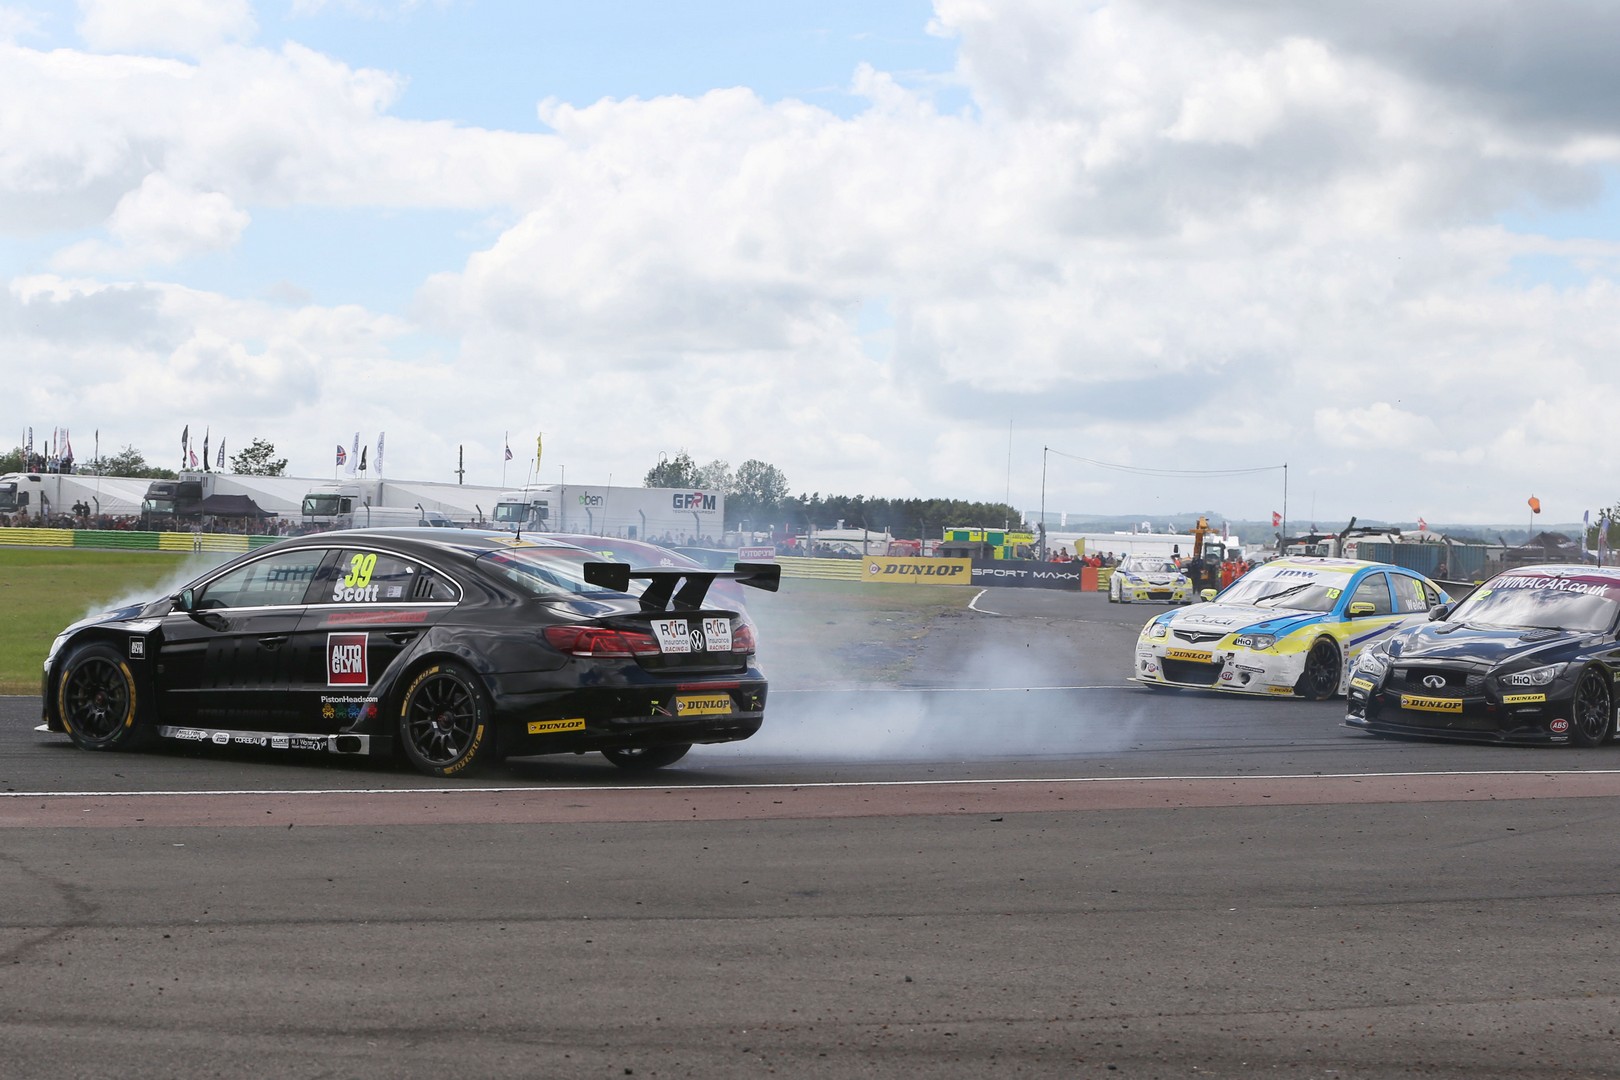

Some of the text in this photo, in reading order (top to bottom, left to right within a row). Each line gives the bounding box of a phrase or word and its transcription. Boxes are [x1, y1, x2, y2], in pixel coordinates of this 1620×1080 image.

[672, 492, 716, 510] GPRM
[344, 553, 377, 588] 39
[883, 564, 963, 576] DUNLOP
[972, 568, 1080, 580] SPORT MAXX
[1273, 568, 1319, 579] jmw
[332, 578, 379, 602] Scott
[1325, 588, 1340, 600] 13
[1412, 579, 1426, 601] 13
[1405, 599, 1427, 611] Welch
[1236, 638, 1252, 646] HiQ
[331, 644, 362, 660] AUTO
[1173, 650, 1213, 661] DUNLOP
[331, 658, 363, 674] GLYM
[1512, 675, 1531, 686] HiQ
[687, 700, 730, 710] DUNLOP
[1411, 699, 1462, 710] DUNLOP
[539, 721, 583, 731] DUNLOP
[1552, 721, 1567, 729] ABS
